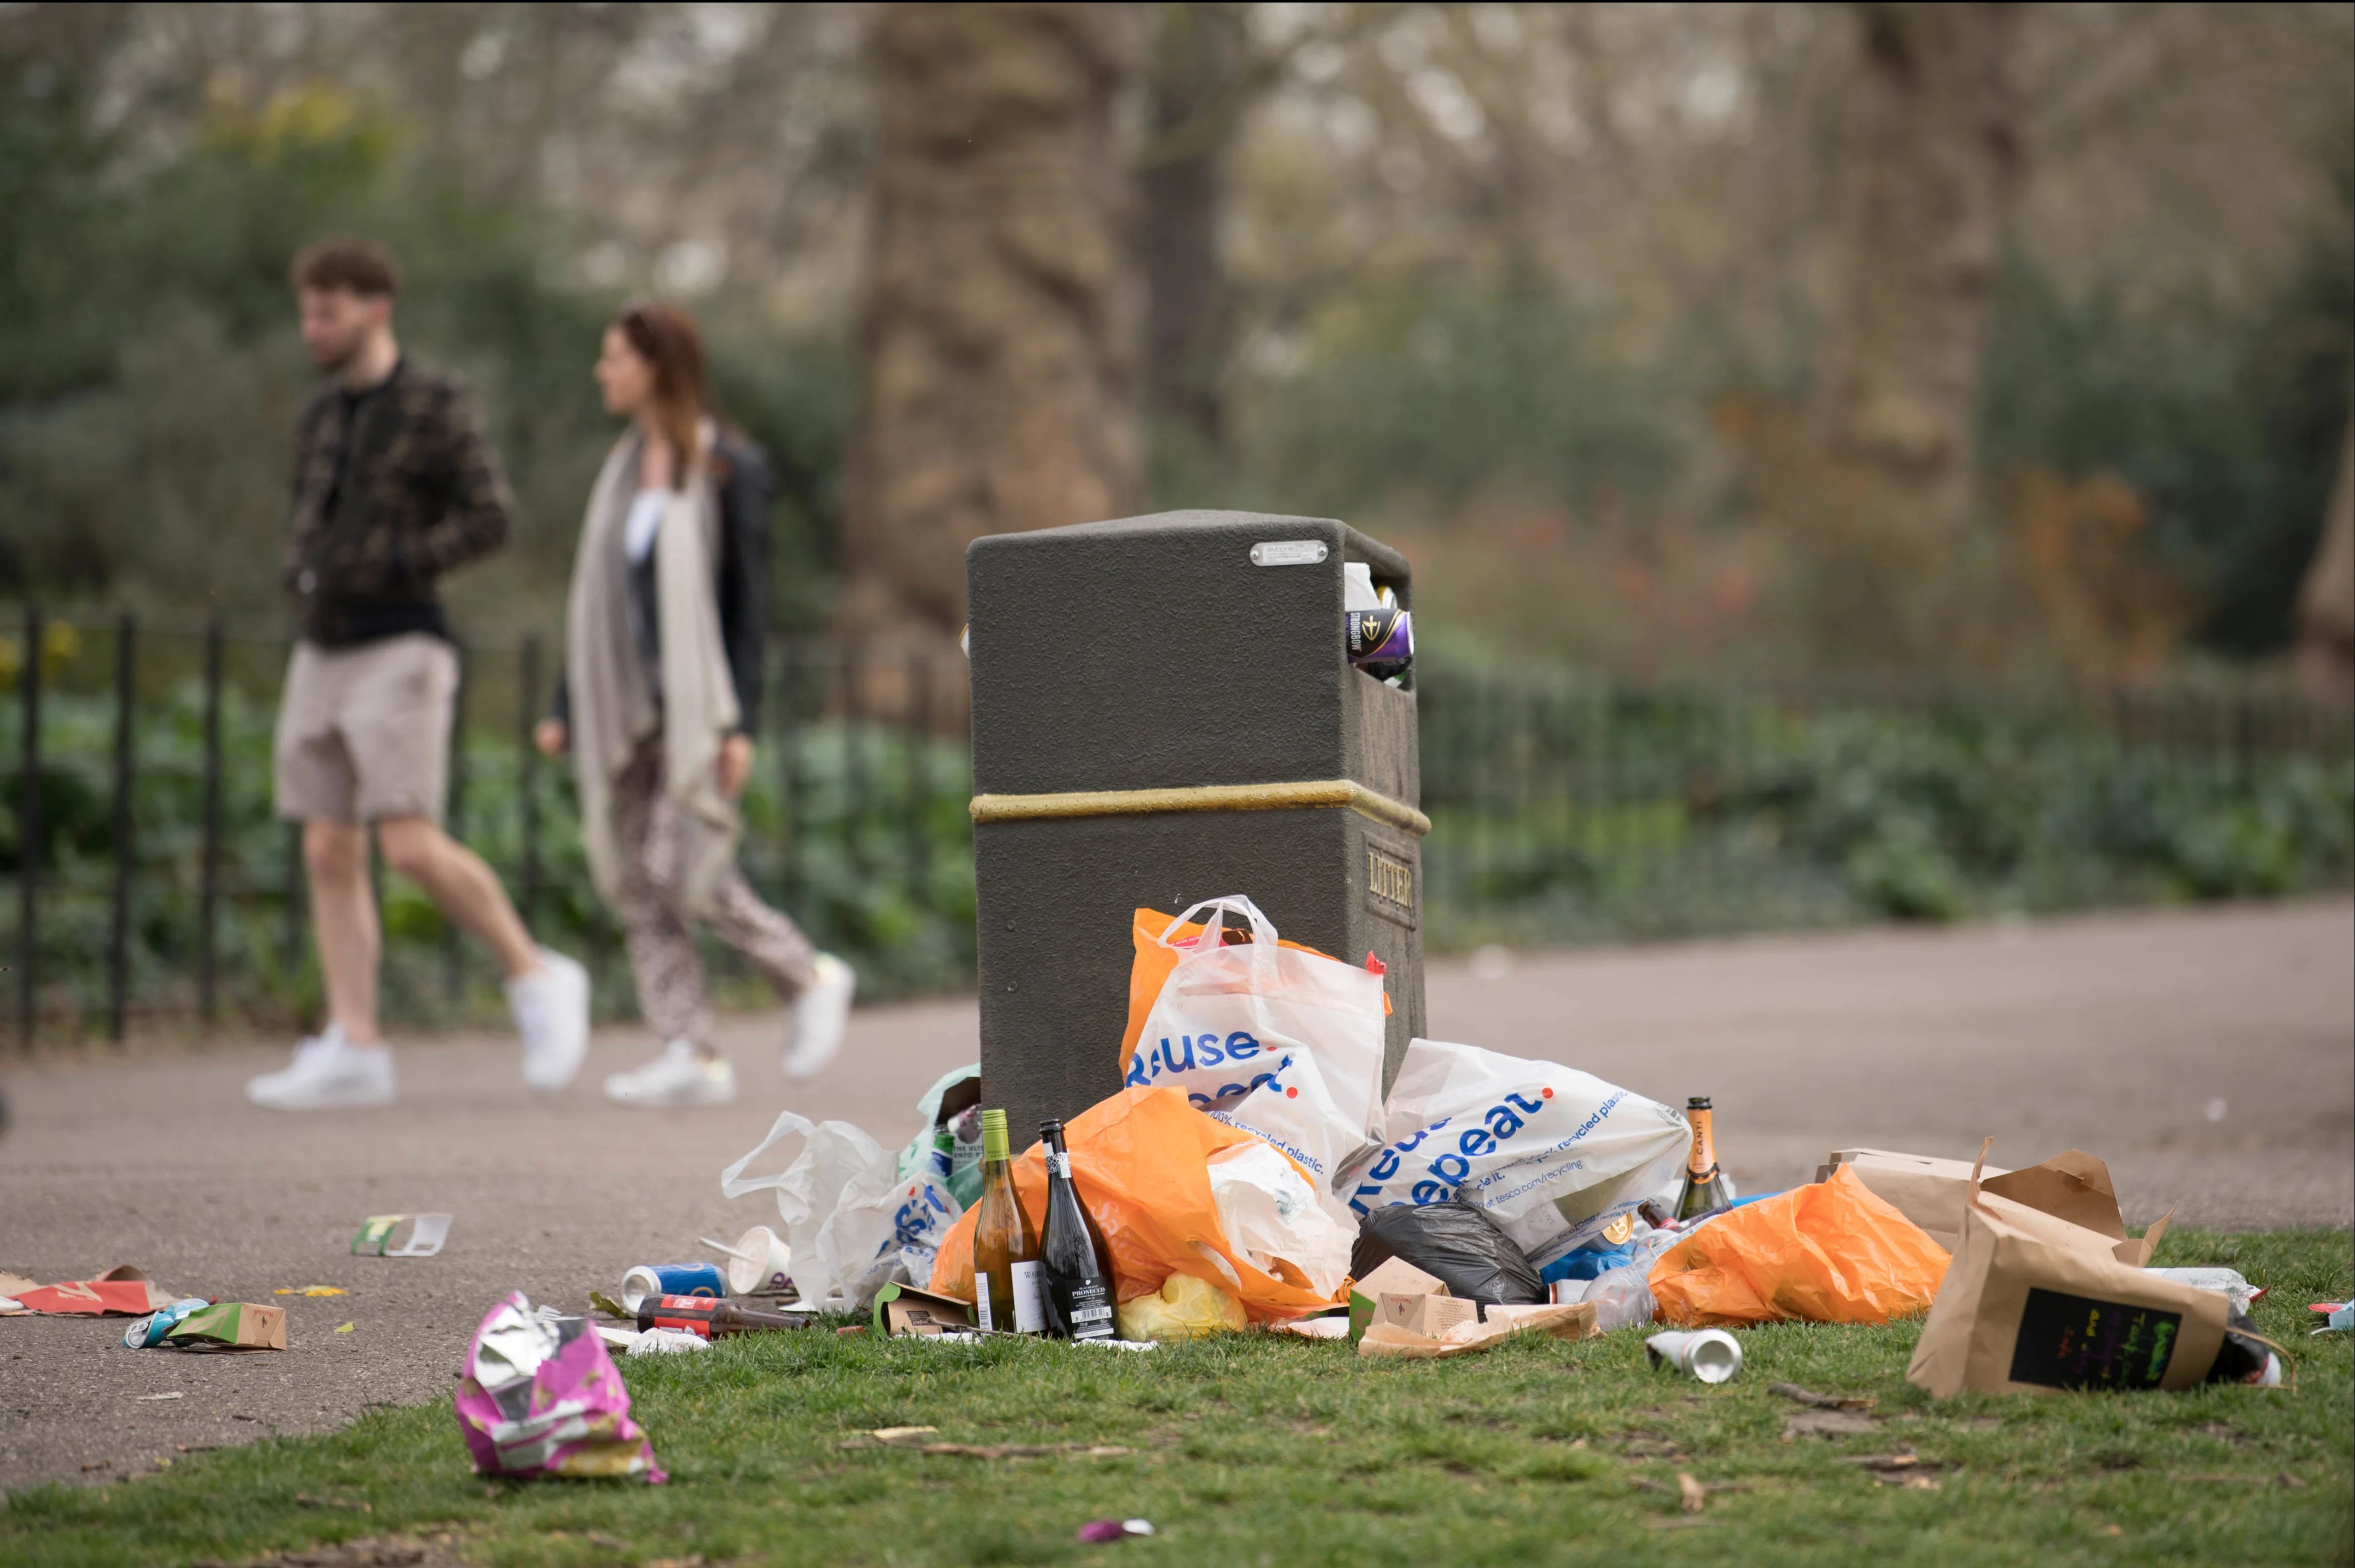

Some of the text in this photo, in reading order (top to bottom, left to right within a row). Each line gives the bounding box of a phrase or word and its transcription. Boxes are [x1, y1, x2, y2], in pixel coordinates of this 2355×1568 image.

[1350, 612, 1361, 651] STRONGBOW
[1368, 852, 1412, 908] LITTER
[1387, 1087, 1553, 1208] epeat.
[1557, 1113, 1601, 1151] recycled
[1286, 1146, 1324, 1175] plastic.
[1486, 1199, 1496, 1208] at
[1496, 1159, 1584, 1204] tesco.com/recycling
[1072, 1287, 1105, 1297] PROSECCO
